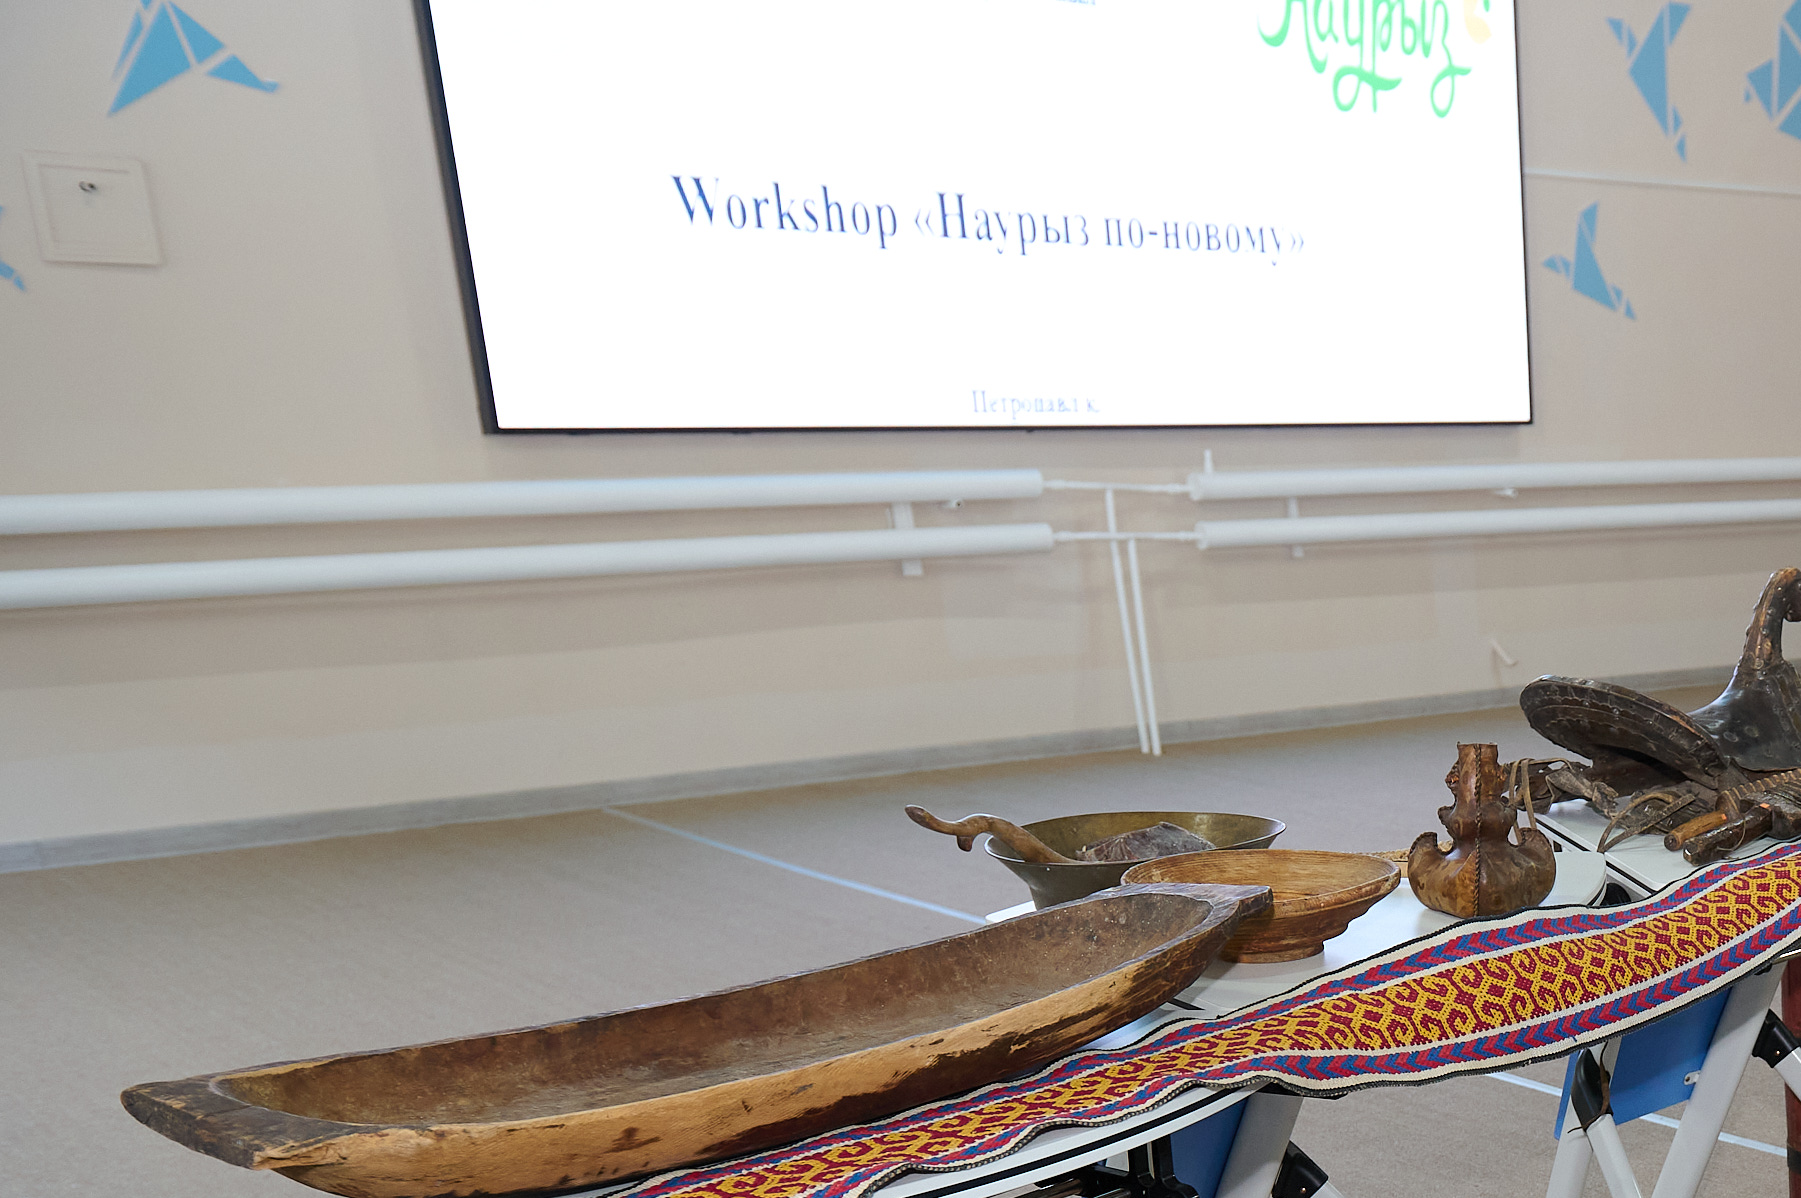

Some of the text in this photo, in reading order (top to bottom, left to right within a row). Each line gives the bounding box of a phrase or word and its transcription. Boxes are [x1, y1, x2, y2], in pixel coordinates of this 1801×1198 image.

[671, 174, 1304, 267] Workshop «Наурыз по-новому»
